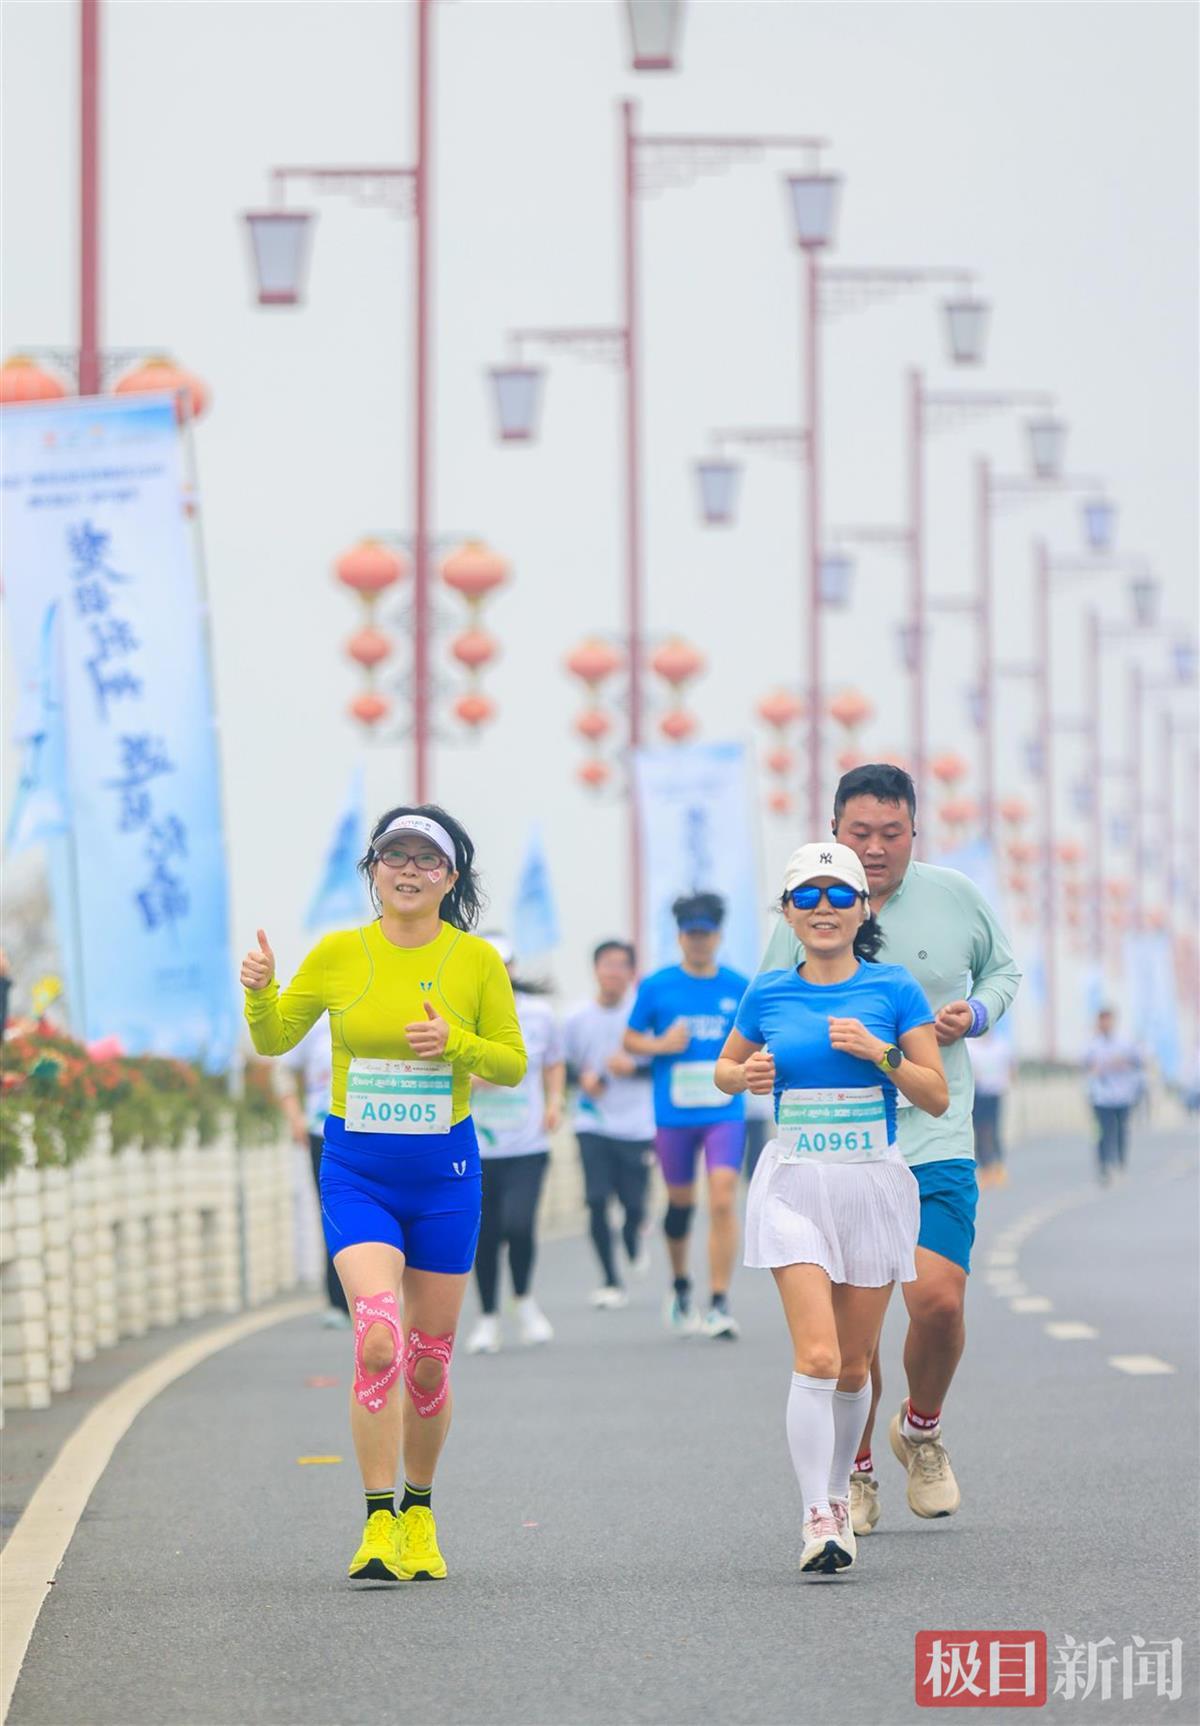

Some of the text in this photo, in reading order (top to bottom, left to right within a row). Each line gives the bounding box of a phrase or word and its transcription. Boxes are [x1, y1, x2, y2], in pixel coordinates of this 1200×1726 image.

[820, 853, 833, 864] NY
[361, 1102, 437, 1123] A0905
[796, 1131, 873, 1153] A0961
